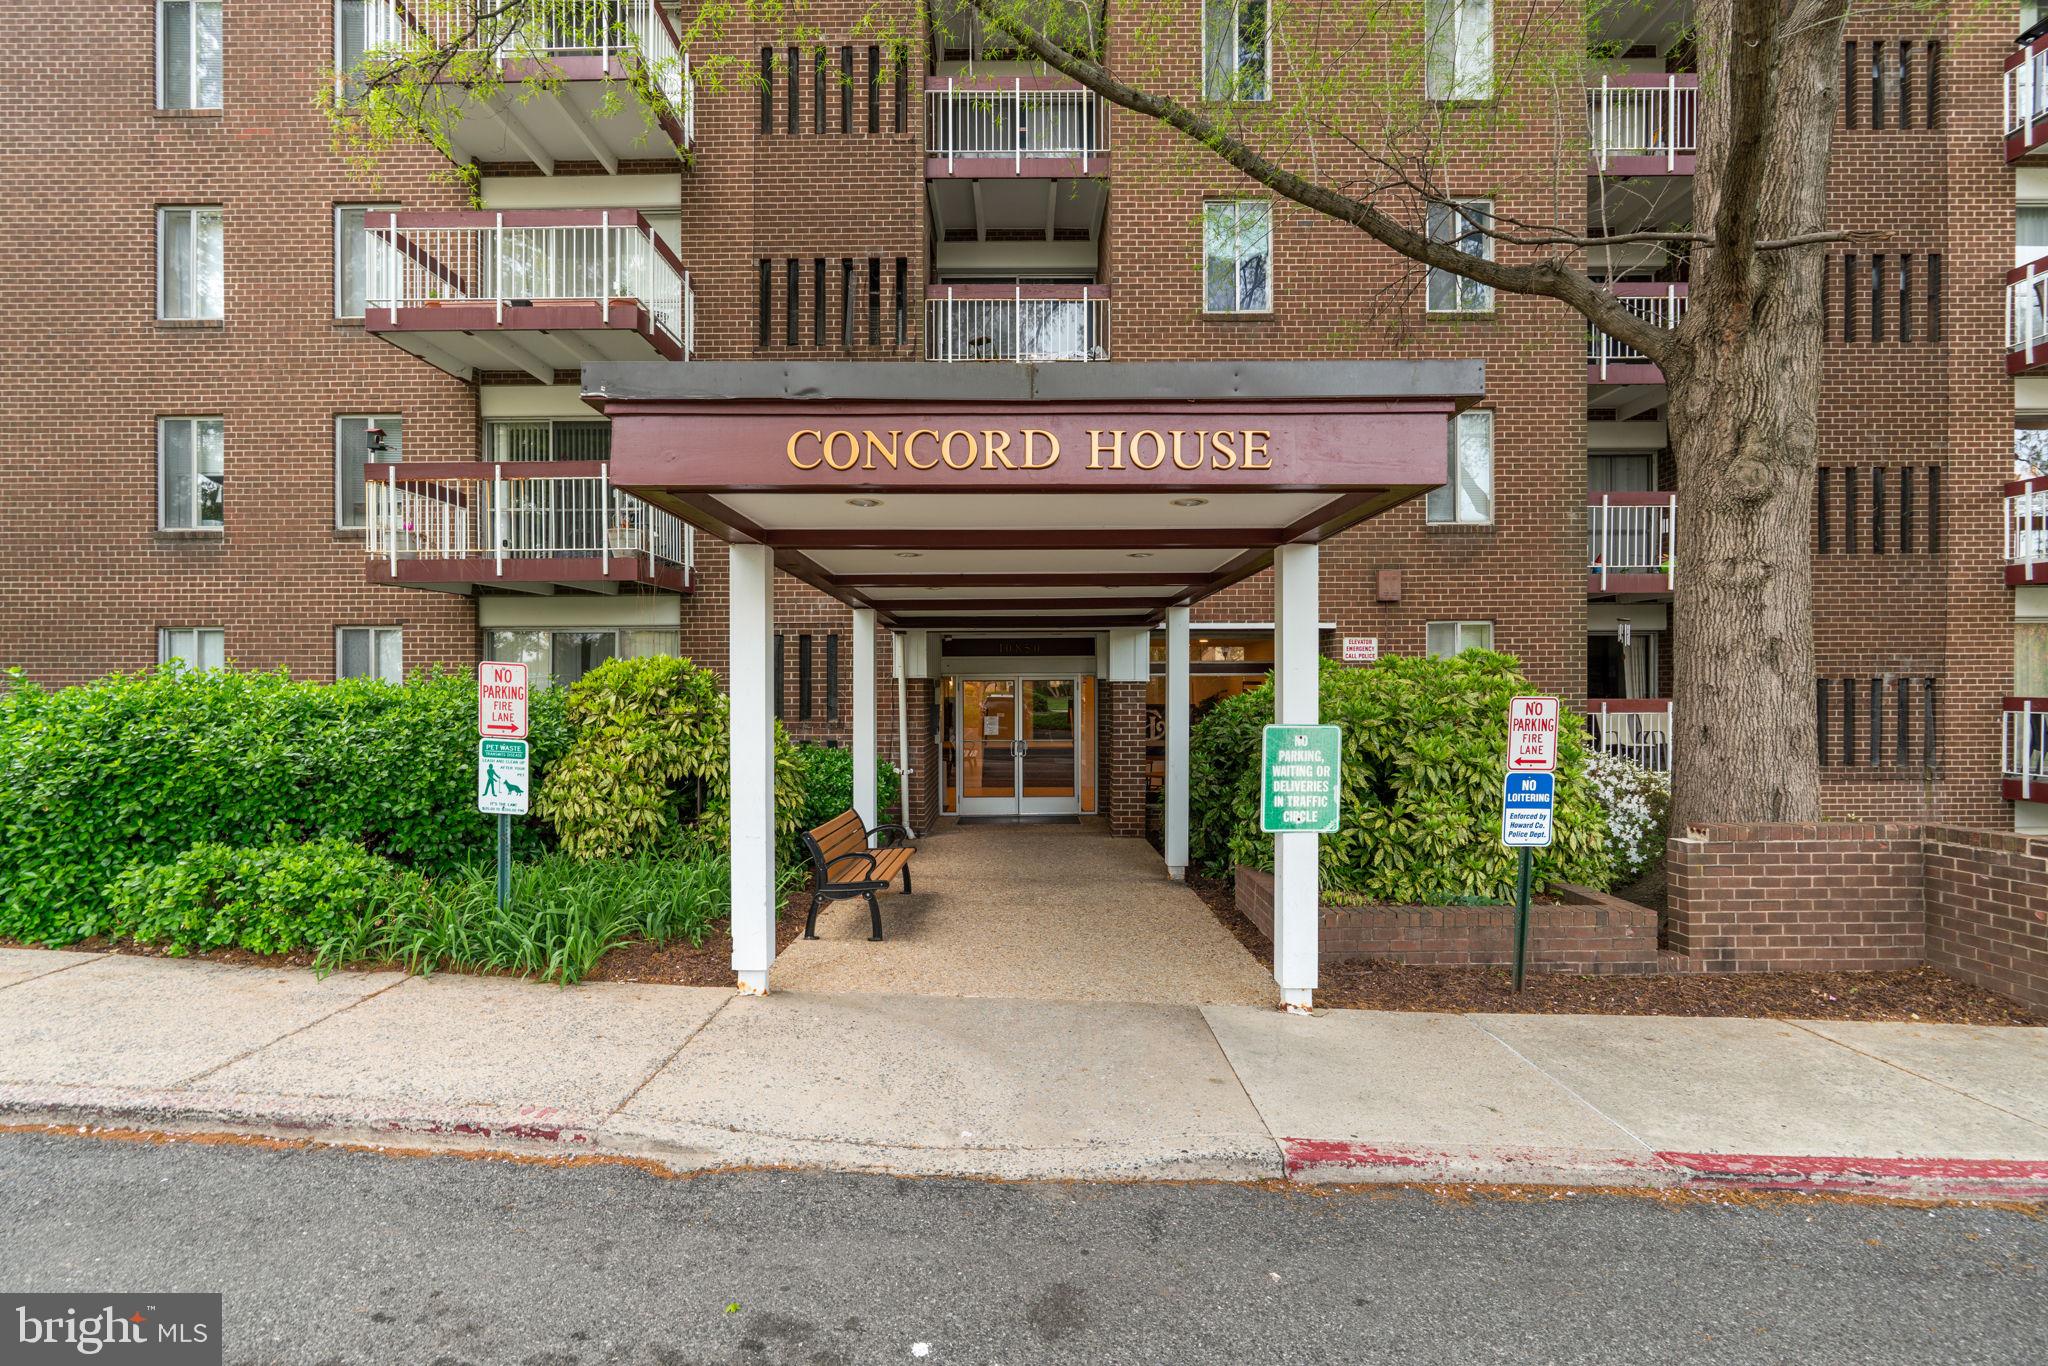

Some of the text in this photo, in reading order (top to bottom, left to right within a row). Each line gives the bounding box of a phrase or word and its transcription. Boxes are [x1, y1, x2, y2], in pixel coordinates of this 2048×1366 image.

[786, 429, 1273, 470] CONCORD HOUSE
[495, 669, 513, 683] NO
[483, 685, 524, 701] PARKING
[494, 701, 513, 711] FIRE
[1525, 702, 1543, 716] NO
[492, 712, 515, 723] LANE
[1513, 718, 1555, 732] PARKING
[1294, 735, 1308, 747] NO
[1522, 734, 1543, 743] FIRE
[1520, 745, 1544, 755] LANE
[1278, 750, 1325, 763] PARKING,
[1272, 765, 1331, 777] WAITING OR
[1273, 780, 1329, 792] DELIVERIES
[1521, 779, 1537, 791] NO
[1273, 795, 1328, 807] IN TRAFFIC
[1507, 793, 1550, 803] LOITERING
[1283, 811, 1318, 823] CIRCLE
[1539, 813, 1547, 821] by
[1529, 831, 1547, 839] Dept.
